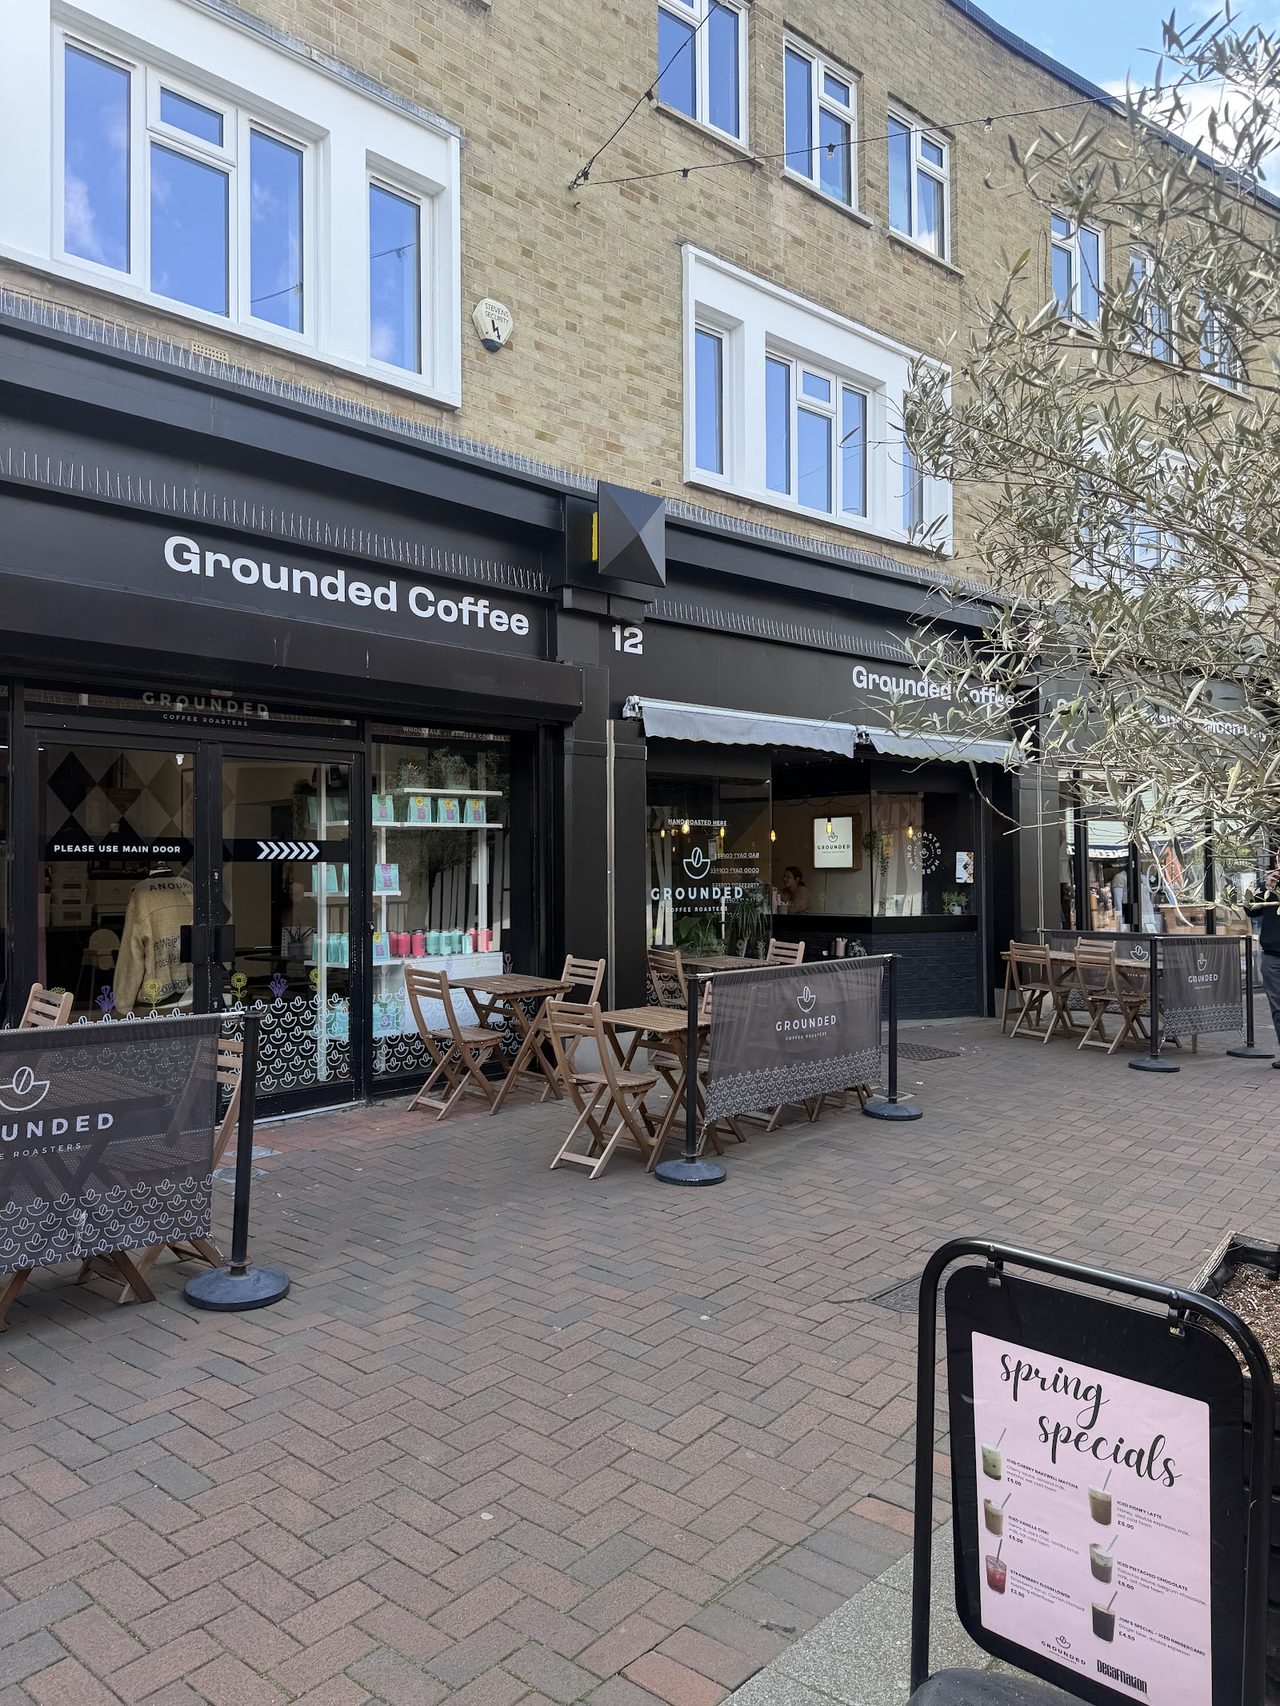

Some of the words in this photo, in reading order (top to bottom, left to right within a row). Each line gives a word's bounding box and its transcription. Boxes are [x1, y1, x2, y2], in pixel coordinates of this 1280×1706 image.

[485, 311, 509, 325] SECURITY
[164, 535, 398, 612] Grounded
[408, 585, 529, 636] Coffee
[612, 624, 643, 655] 12
[852, 665, 951, 701] Grounded
[958, 683, 1015, 707] offee
[142, 691, 269, 716] GROUNDED
[163, 714, 198, 722] COFFEE
[203, 718, 248, 727] ROASTERS
[99, 845, 119, 853] USE
[122, 845, 148, 853] MAIN
[650, 887, 743, 900] GROUNDED
[776, 1015, 836, 1031] GROUNDED
[13, 1142, 81, 1158] ROASTERS
[1000, 1354, 1110, 1430] spring
[1038, 1416, 1182, 1487] specials
[1157, 1576, 1188, 1592] CHOCOLATE
[1041, 1640, 1086, 1665] GROUNDED
